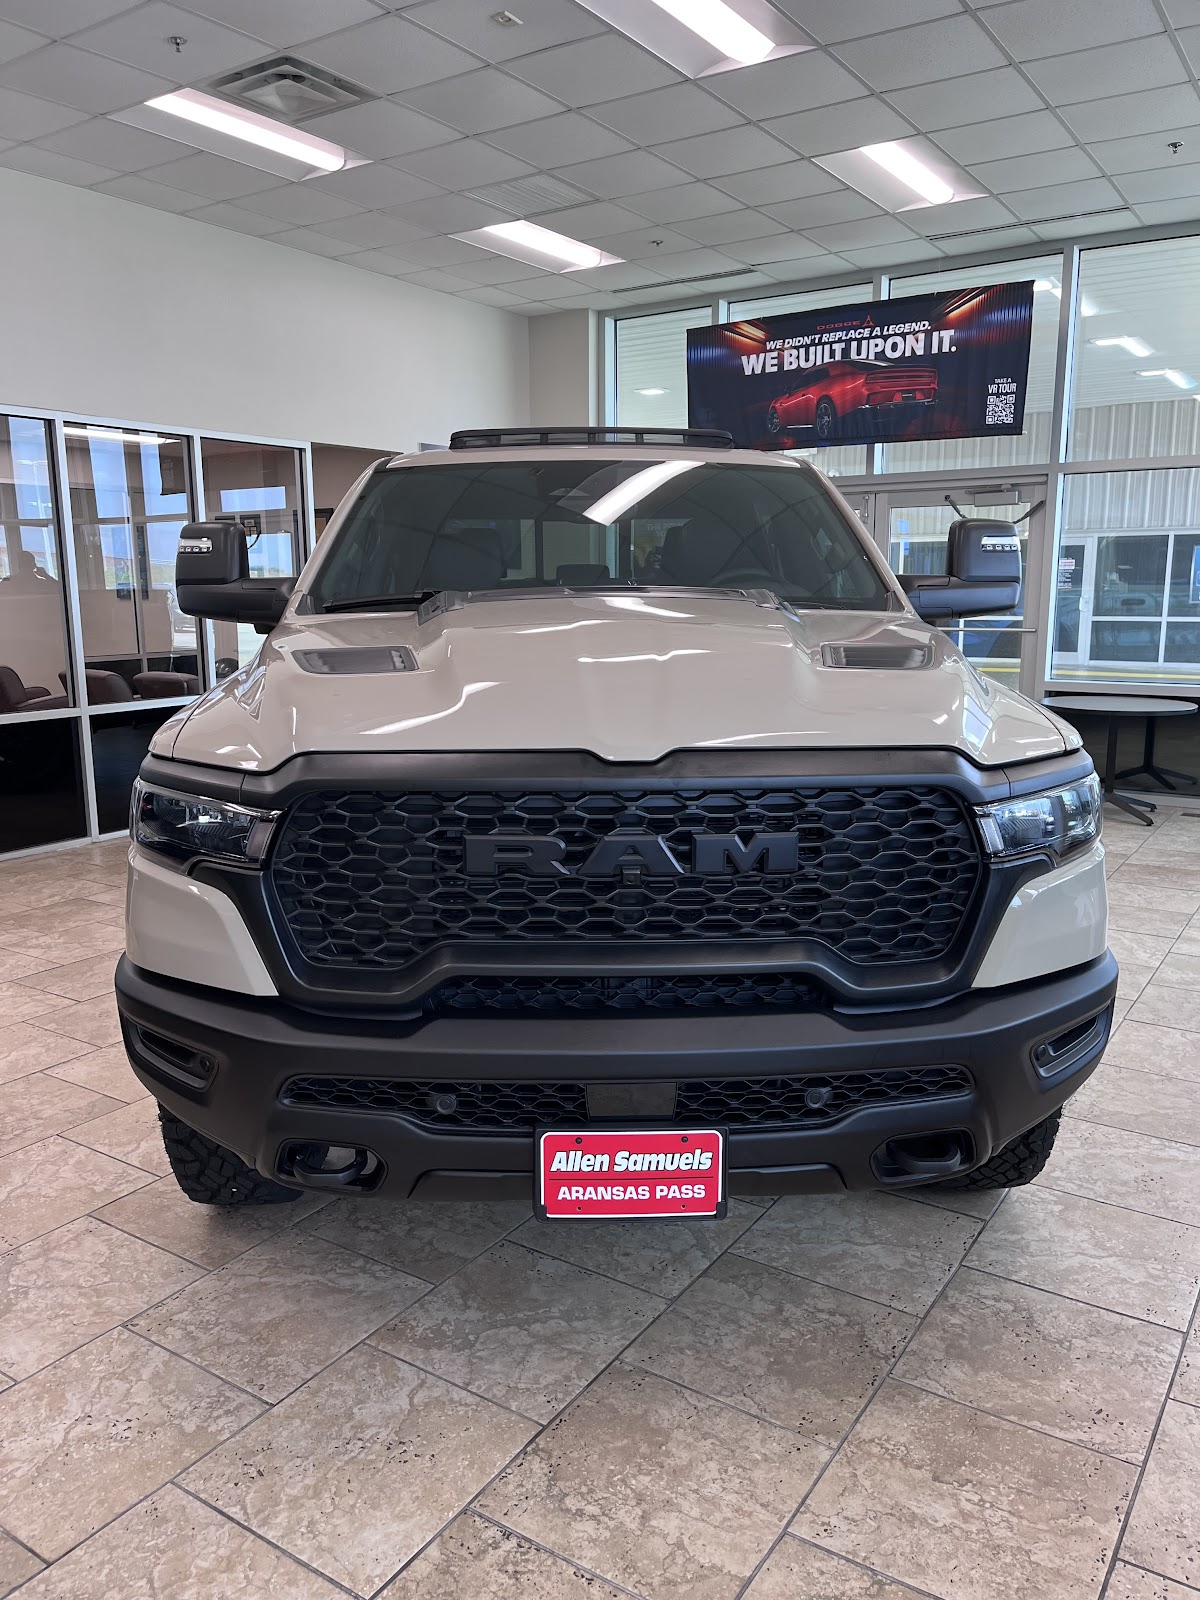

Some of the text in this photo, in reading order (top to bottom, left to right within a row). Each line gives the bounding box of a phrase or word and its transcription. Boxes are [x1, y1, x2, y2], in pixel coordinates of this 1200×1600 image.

[766, 321, 931, 350] WE DIDN'T REPLACE A LEGEND.
[817, 321, 860, 330] DODGE
[741, 329, 957, 375] WE BUILT UPON IT.
[988, 383, 1017, 393] VR TOUR
[463, 832, 799, 875] RAM
[550, 1149, 712, 1172] Allen Samuels
[557, 1184, 706, 1200] ARANSAS PASS
